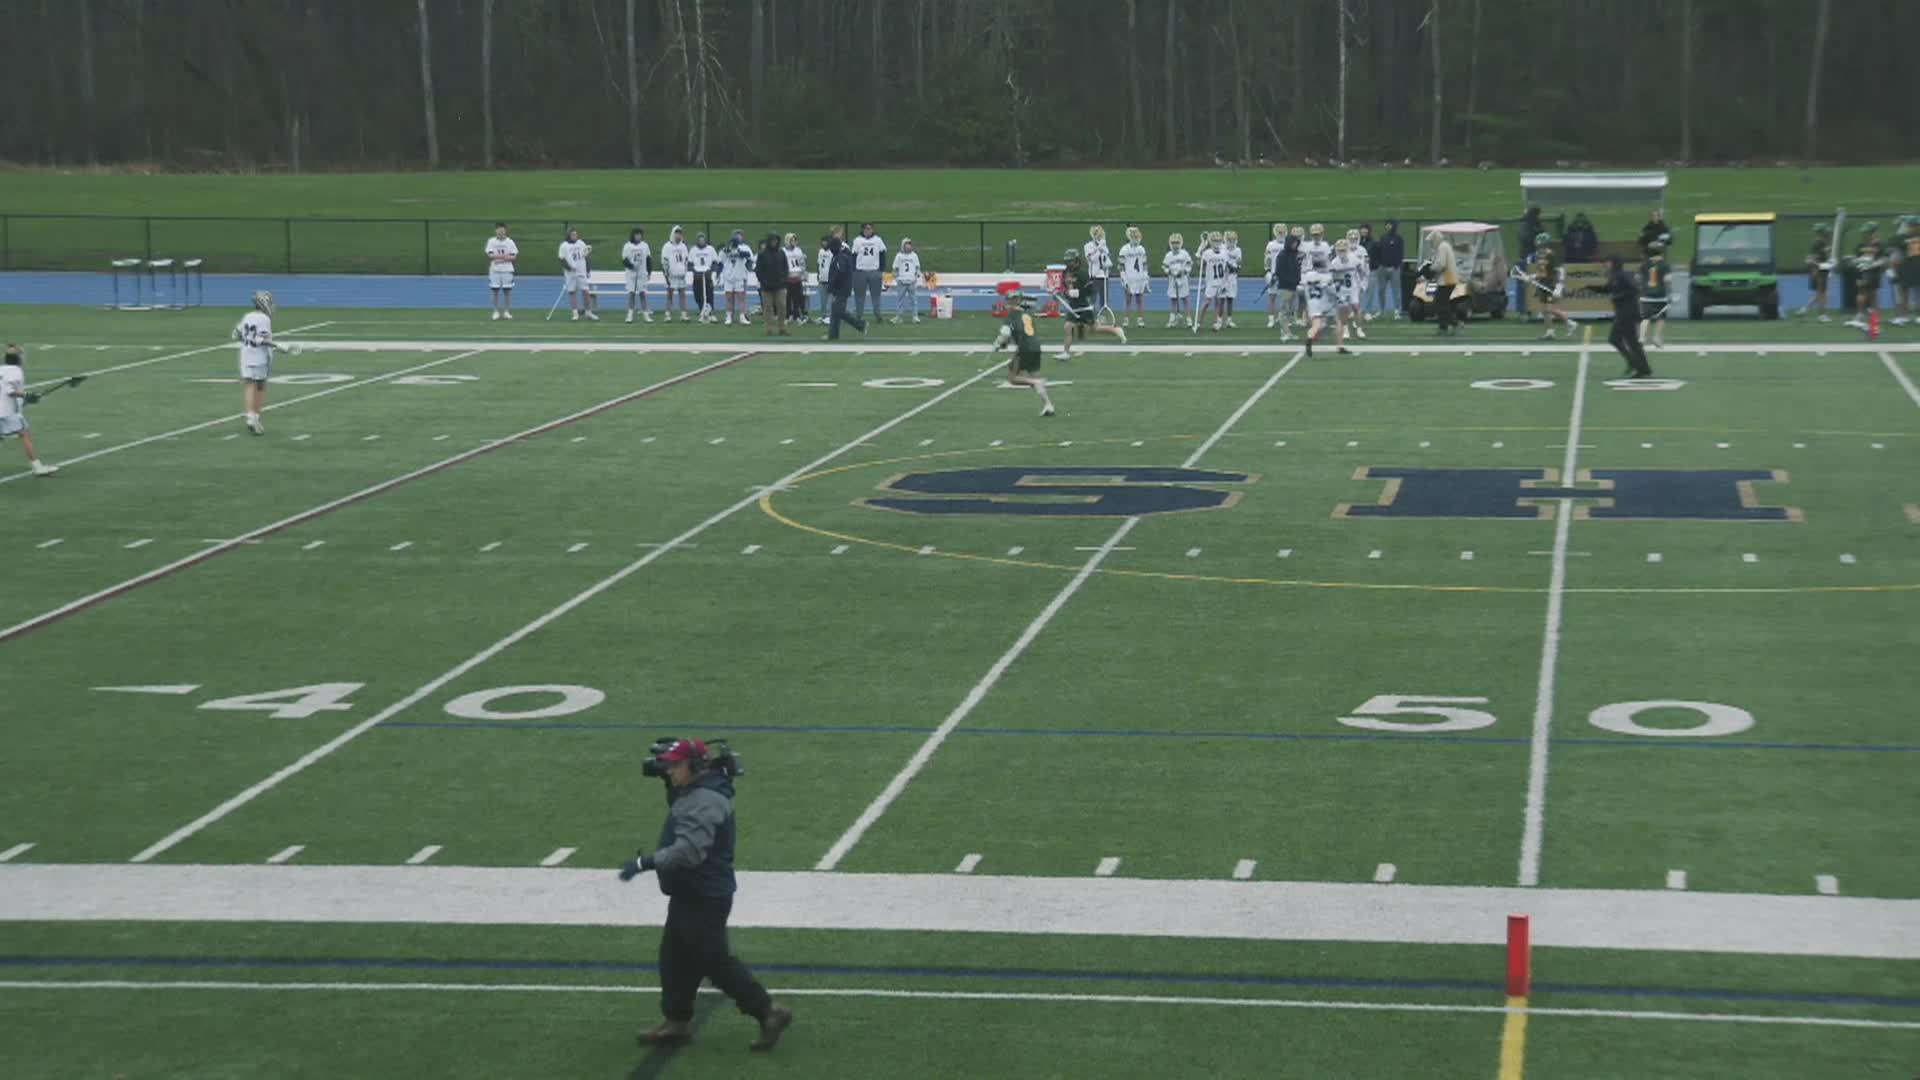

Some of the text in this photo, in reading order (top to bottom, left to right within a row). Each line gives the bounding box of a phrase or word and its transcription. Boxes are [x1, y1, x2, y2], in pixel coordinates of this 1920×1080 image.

[863, 247, 874, 257] 24
[1133, 257, 1140, 272] 4
[1213, 263, 1224, 279] 10
[197, 682, 606, 720] 40
[1337, 694, 1755, 737] 50
